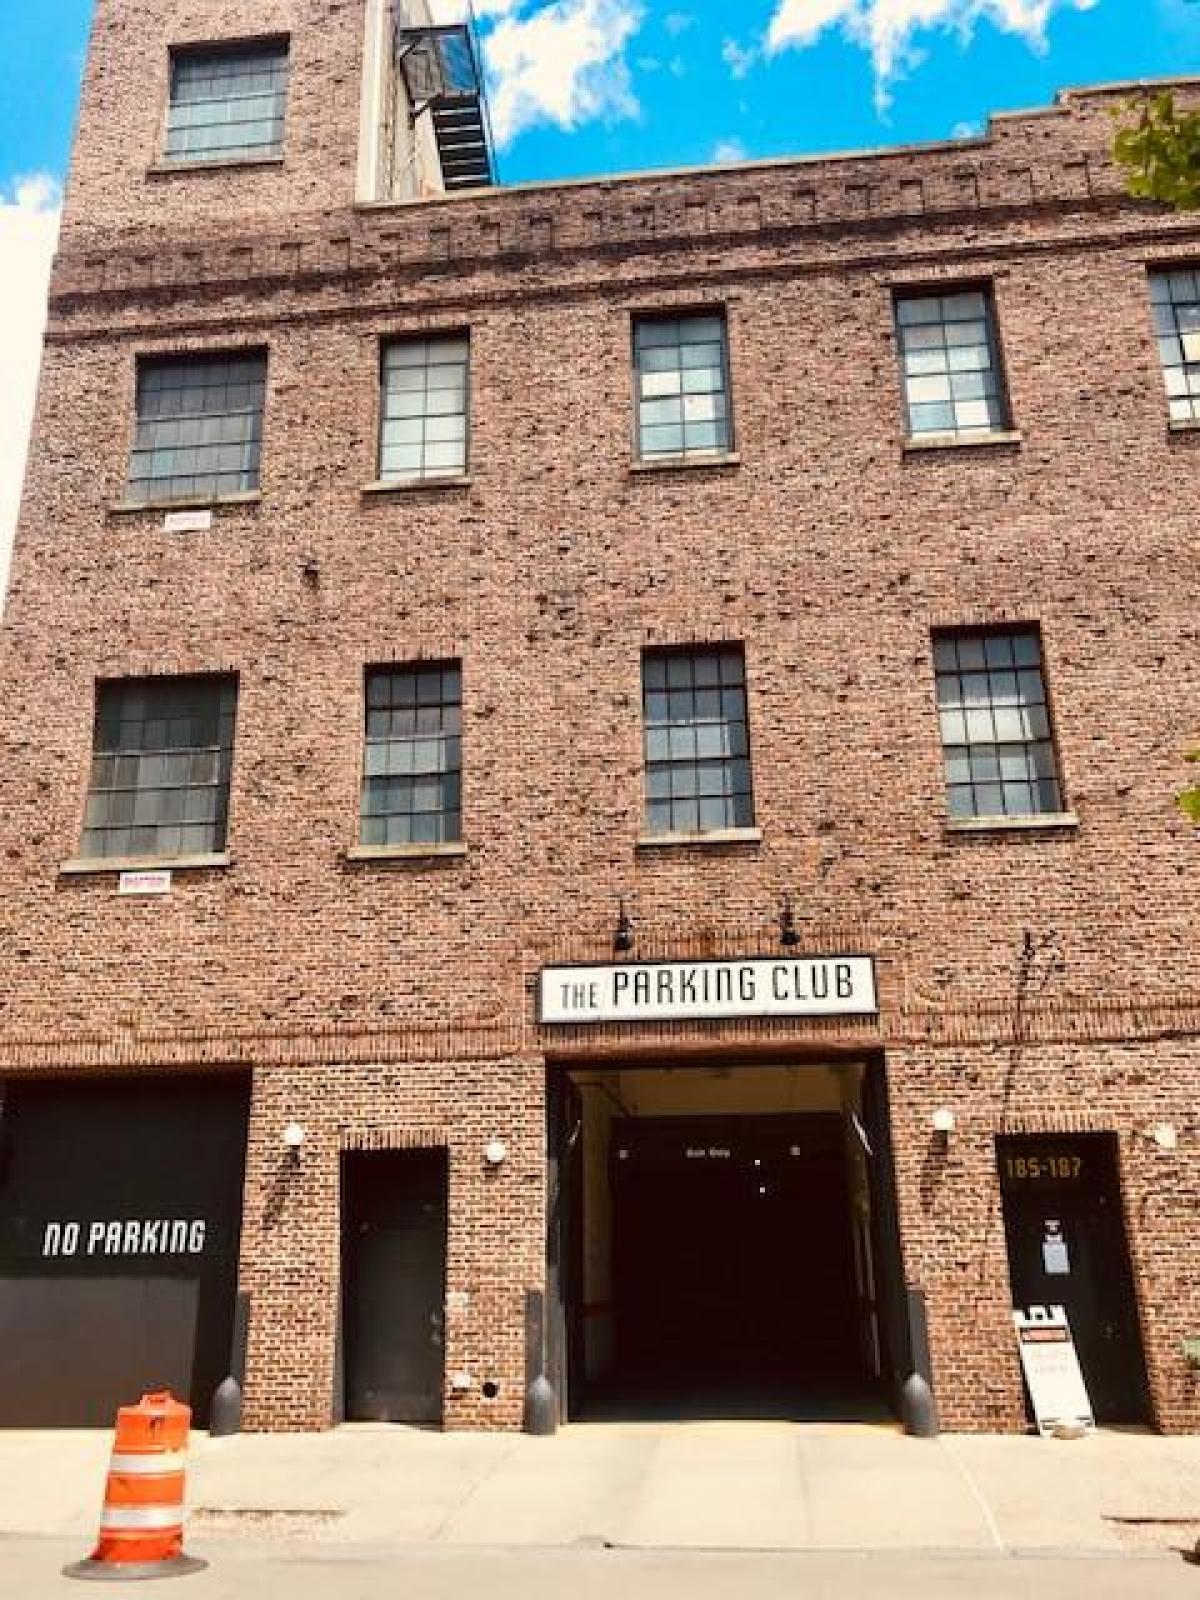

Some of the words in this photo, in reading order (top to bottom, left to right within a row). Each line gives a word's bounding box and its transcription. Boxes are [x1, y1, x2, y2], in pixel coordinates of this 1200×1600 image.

[560, 982, 599, 1009] THE
[612, 967, 756, 1006] PARKING
[772, 964, 852, 1000] CLUB
[1006, 1157, 1081, 1178] 185-187
[42, 1222, 81, 1256] NO
[87, 1219, 206, 1255] PARKING
